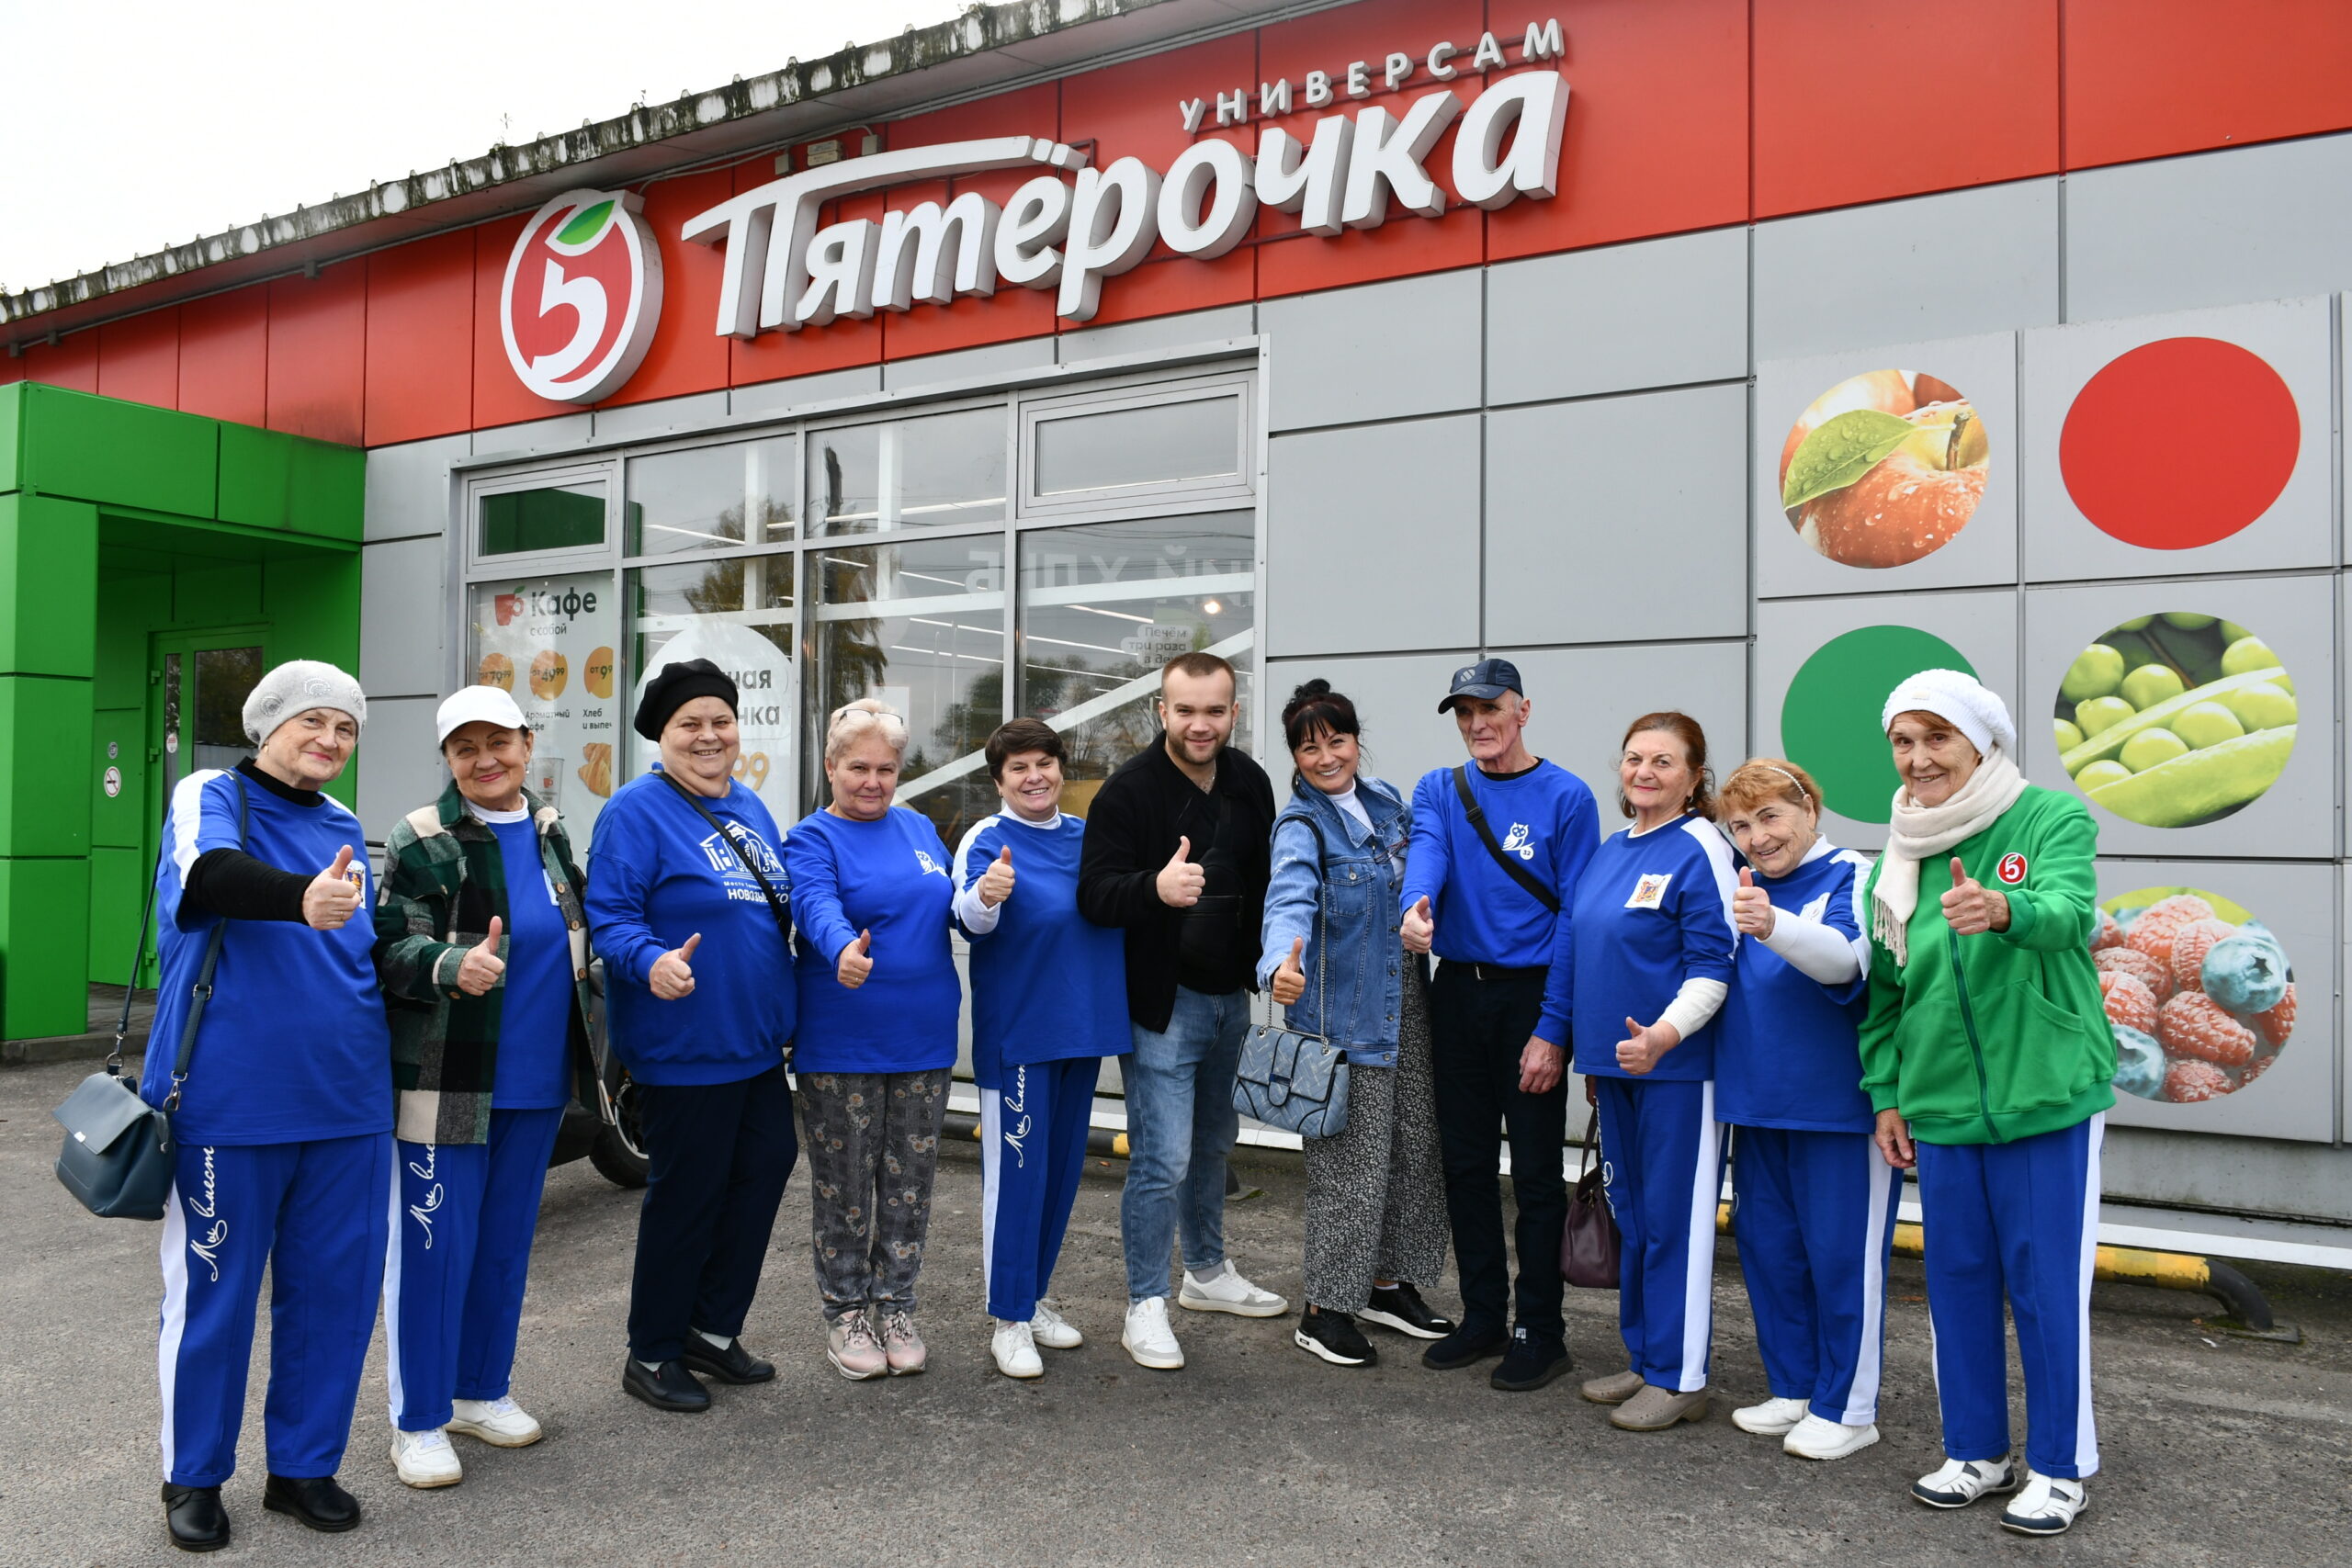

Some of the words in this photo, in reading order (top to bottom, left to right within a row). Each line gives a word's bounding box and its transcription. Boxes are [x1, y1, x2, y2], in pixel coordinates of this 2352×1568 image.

[1180, 18, 1565, 133] УНИВЕРСАМ
[681, 70, 1570, 341] Пятёрочка
[531, 586, 597, 621] Кафе
[537, 623, 567, 636] собой
[1145, 626, 1188, 638] Печём
[1129, 641, 1152, 652] три
[1155, 642, 1187, 652] раза
[590, 666, 600, 674] от
[526, 708, 571, 720] Ароматный
[582, 707, 603, 718] Хлеб
